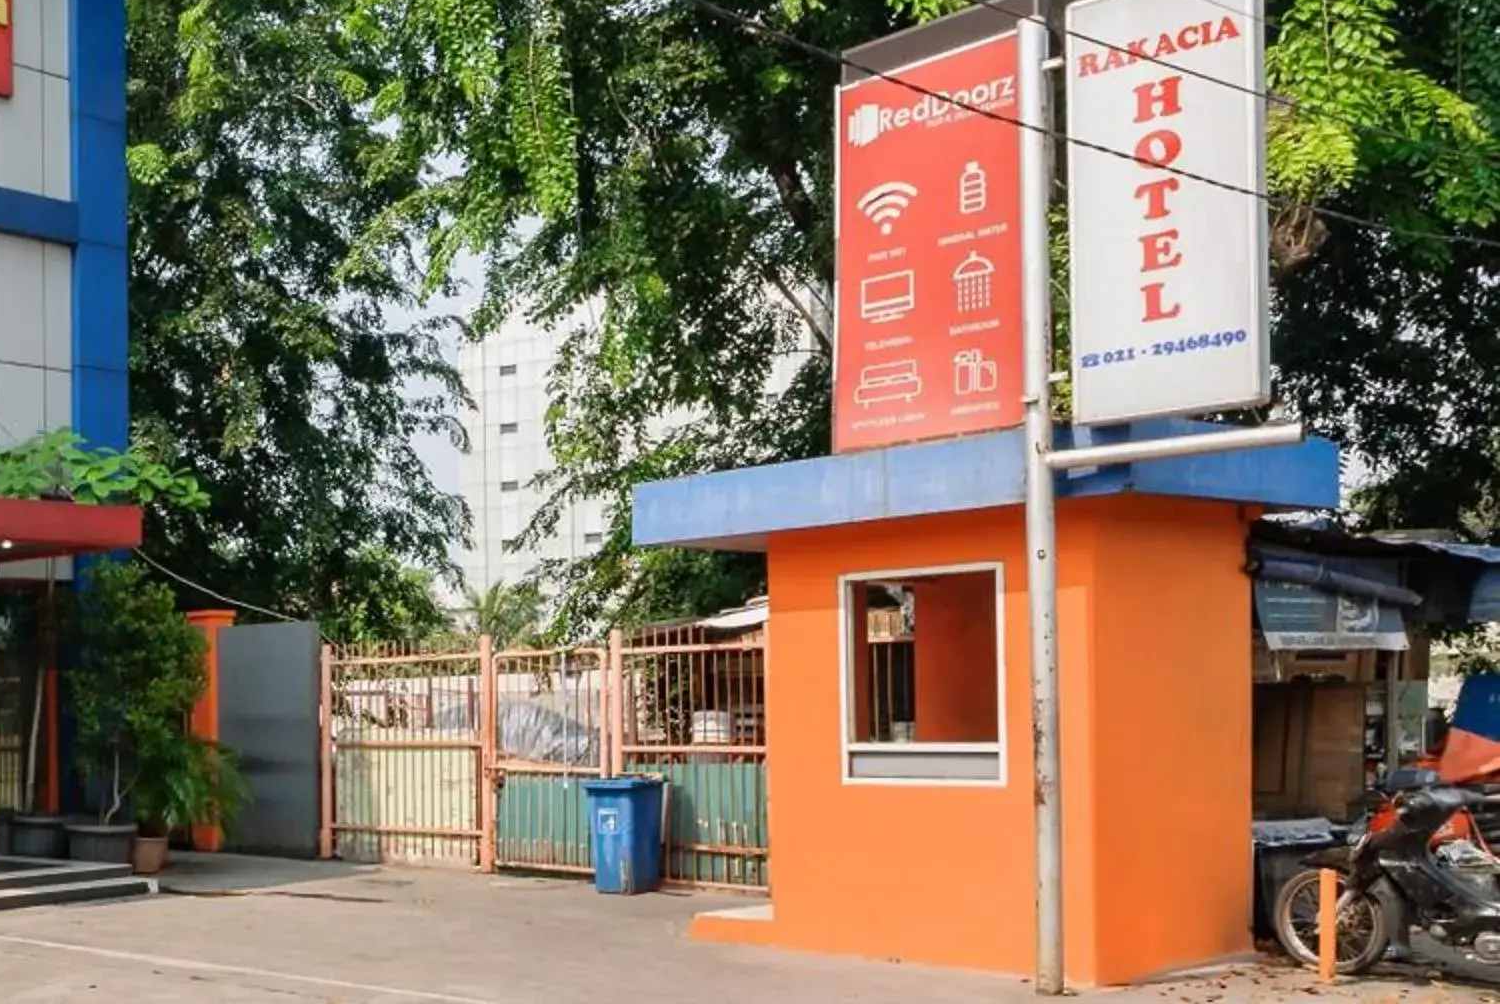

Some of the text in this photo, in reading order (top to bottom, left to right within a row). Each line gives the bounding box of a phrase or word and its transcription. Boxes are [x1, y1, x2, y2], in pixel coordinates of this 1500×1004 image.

[1077, 15, 1241, 78] RAKACIA
[880, 74, 1015, 133] RedDoorz
[1132, 75, 1184, 323] HOTEL
[1103, 347, 1136, 364] 021
[1151, 329, 1247, 355] 29468490
